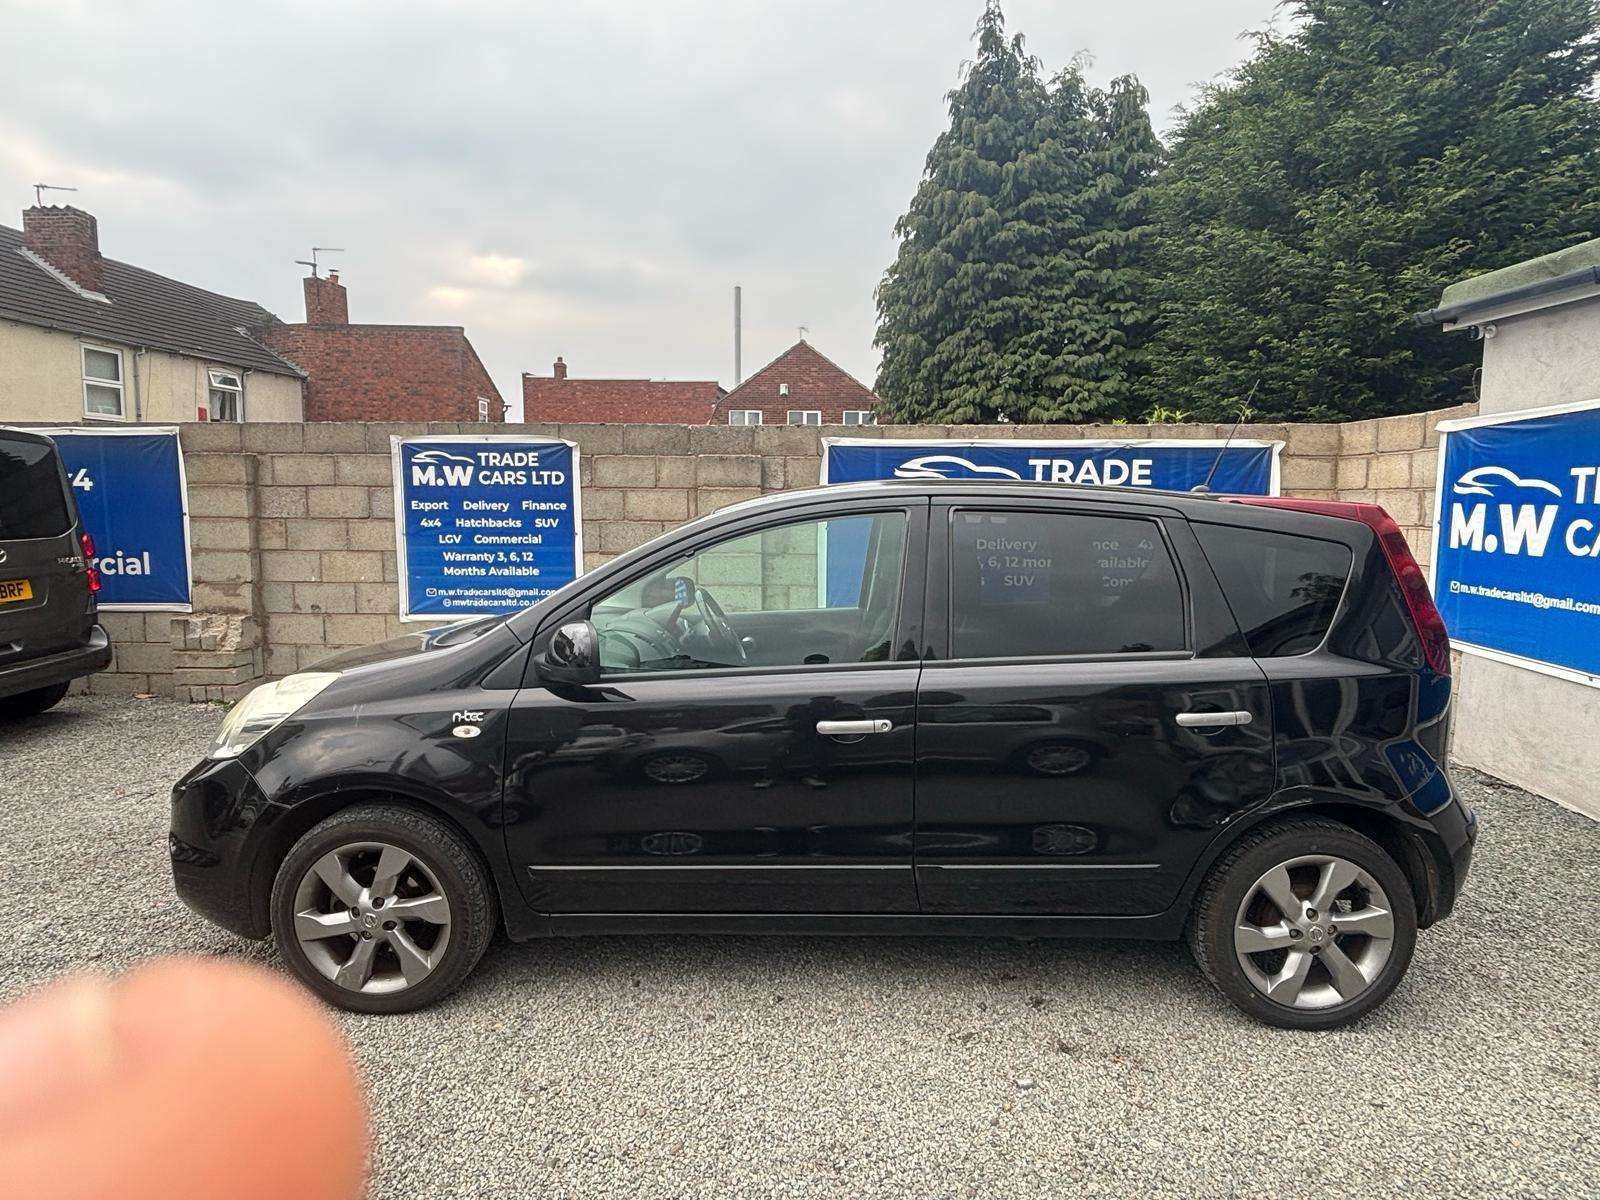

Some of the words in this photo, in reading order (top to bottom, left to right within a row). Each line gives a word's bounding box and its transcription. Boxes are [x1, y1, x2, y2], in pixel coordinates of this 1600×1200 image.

[477, 452, 539, 467] TRADE
[412, 465, 474, 486] M.W
[478, 471, 527, 485] CARS
[532, 471, 565, 485] LTD
[1028, 459, 1153, 486] TRADE
[1570, 466, 1600, 504] T
[411, 501, 449, 512] Export
[463, 501, 510, 512] Delivery
[522, 501, 567, 511] Finance
[420, 518, 442, 528] 4x4
[456, 518, 522, 528] Hatchbacks
[535, 518, 559, 528] SUV
[1449, 502, 1559, 557] M.W
[438, 534, 462, 544] LGV
[474, 534, 542, 544] Commercial
[976, 538, 1037, 552] Delivery
[443, 552, 495, 563] Warranty
[497, 552, 507, 563] 3,
[509, 552, 520, 563] 6,
[522, 552, 534, 561] 12
[1005, 556, 1019, 568] 12
[443, 566, 487, 576] Months
[488, 566, 540, 576] Available
[1004, 575, 1035, 587] SUV
